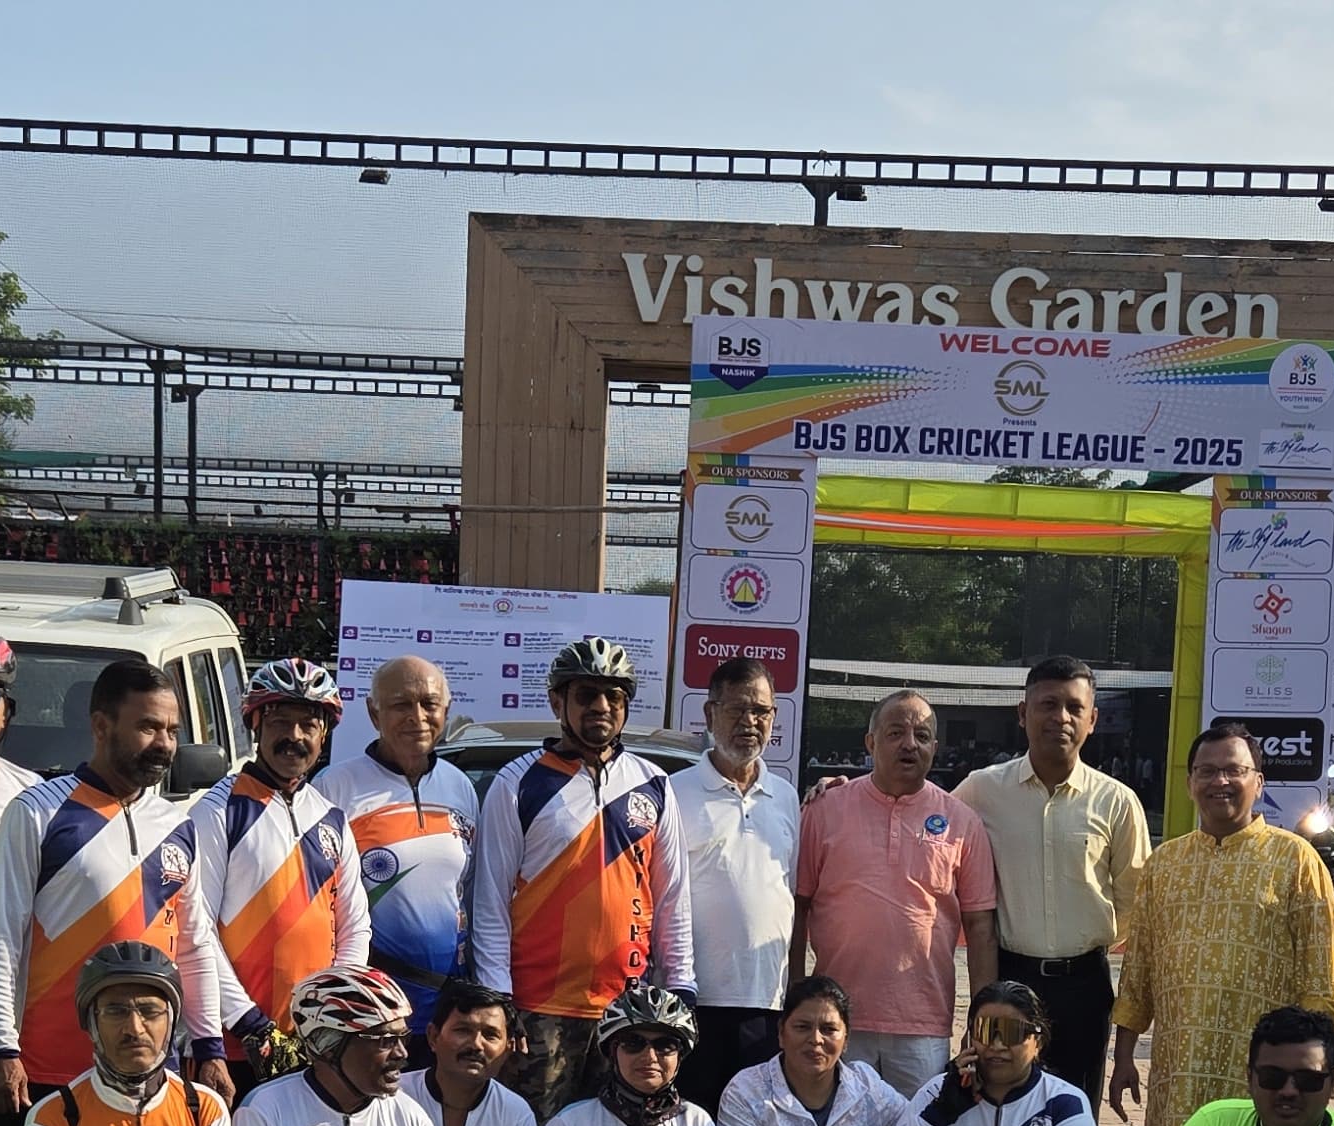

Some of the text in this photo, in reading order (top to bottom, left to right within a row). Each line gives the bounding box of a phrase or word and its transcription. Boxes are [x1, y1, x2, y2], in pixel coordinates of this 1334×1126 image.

[622, 253, 1280, 340] Vishwas Garden
[718, 336, 762, 357] BJS
[939, 332, 1112, 358] WELCOME
[721, 367, 756, 377] NASHIK
[1289, 372, 1317, 386] BJS
[993, 379, 1051, 398] SML
[1280, 394, 1324, 404] YOUTH WING
[1002, 416, 1037, 427] Presents
[793, 421, 847, 451] BJS
[855, 423, 911, 454] BOX
[918, 426, 1035, 461] CRICKET
[1042, 429, 1147, 464] LEAGUE
[1173, 436, 1244, 467] 2025
[711, 466, 789, 480] OUR SPONSORS
[1240, 488, 1318, 500] OUR SPONSORS
[725, 511, 774, 527] SML
[1252, 624, 1292, 636] Shagun
[698, 636, 786, 660] SONY GIFTS
[1245, 686, 1293, 696] BLISS
